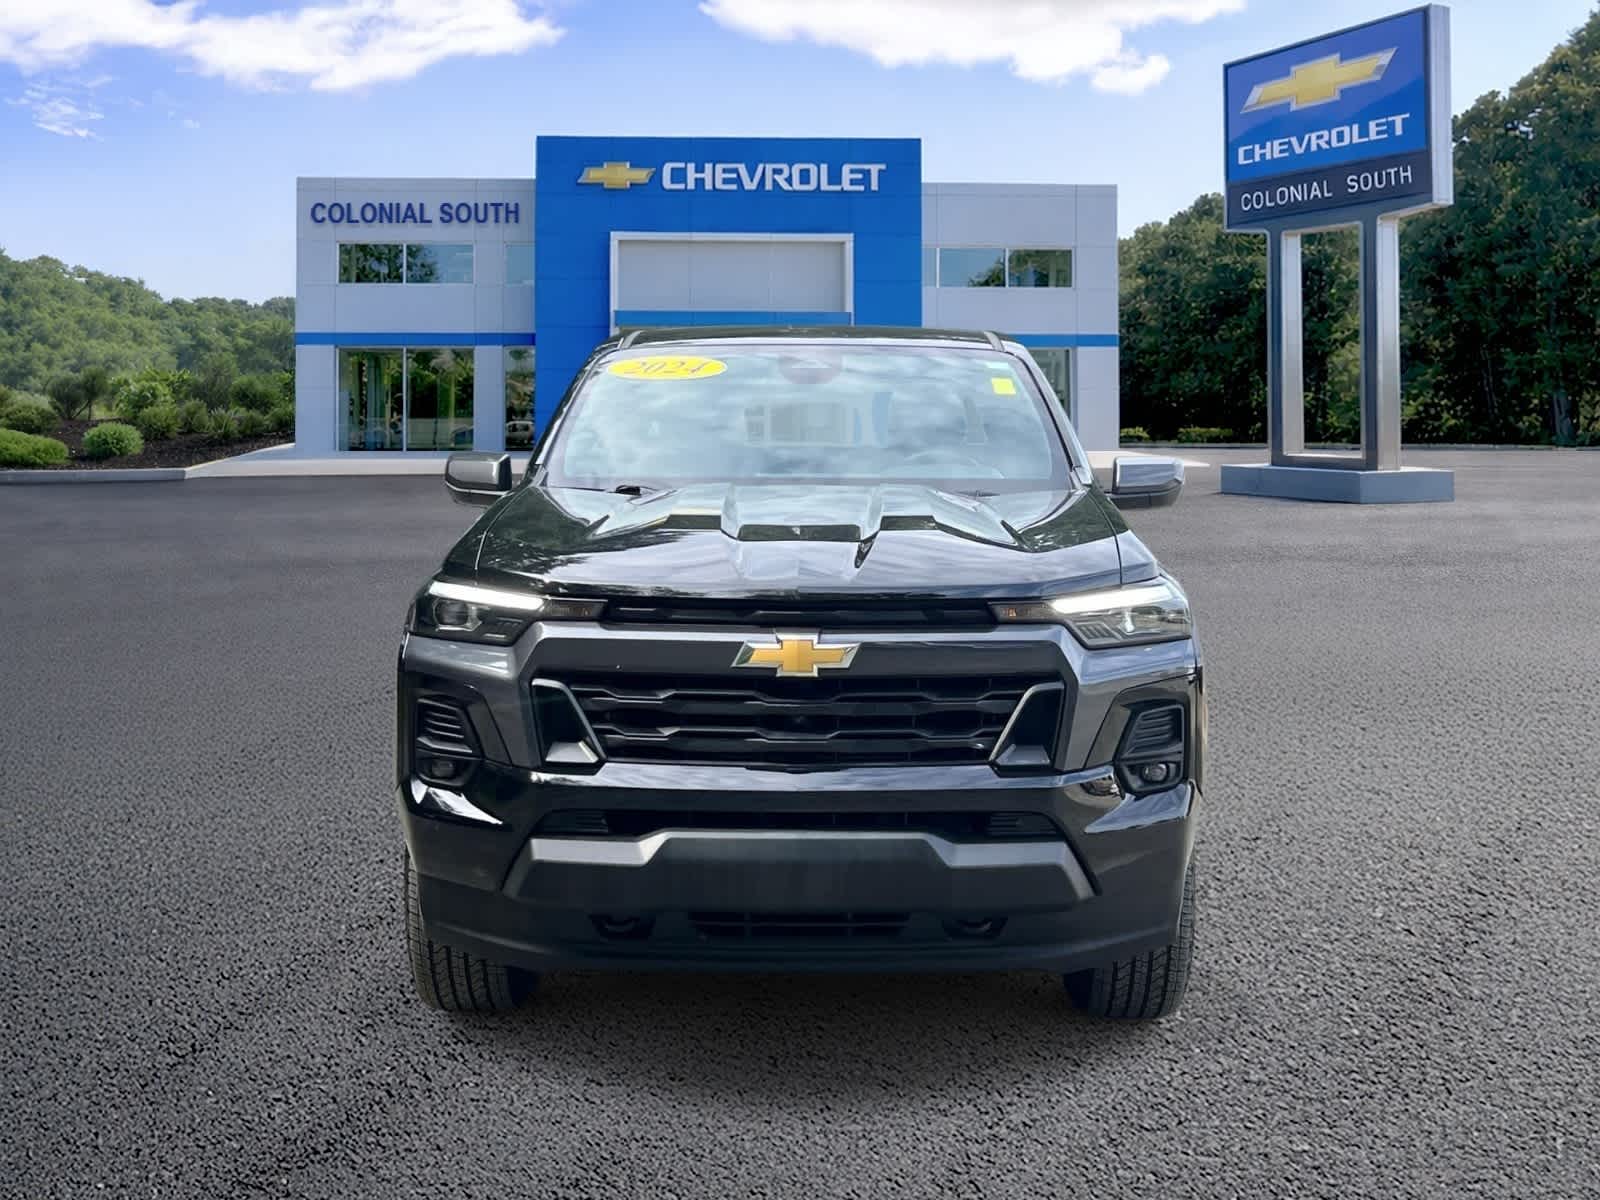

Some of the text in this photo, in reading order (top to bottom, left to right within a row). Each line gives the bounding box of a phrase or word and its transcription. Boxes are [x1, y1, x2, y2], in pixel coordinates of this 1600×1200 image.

[1237, 113, 1410, 165] CHEVROLET
[662, 162, 887, 191] CHEVROLET
[1240, 165, 1413, 211] COLONIAL SOUTH
[310, 202, 520, 224] COLONIAL SOUTH
[621, 359, 713, 377] 2024
